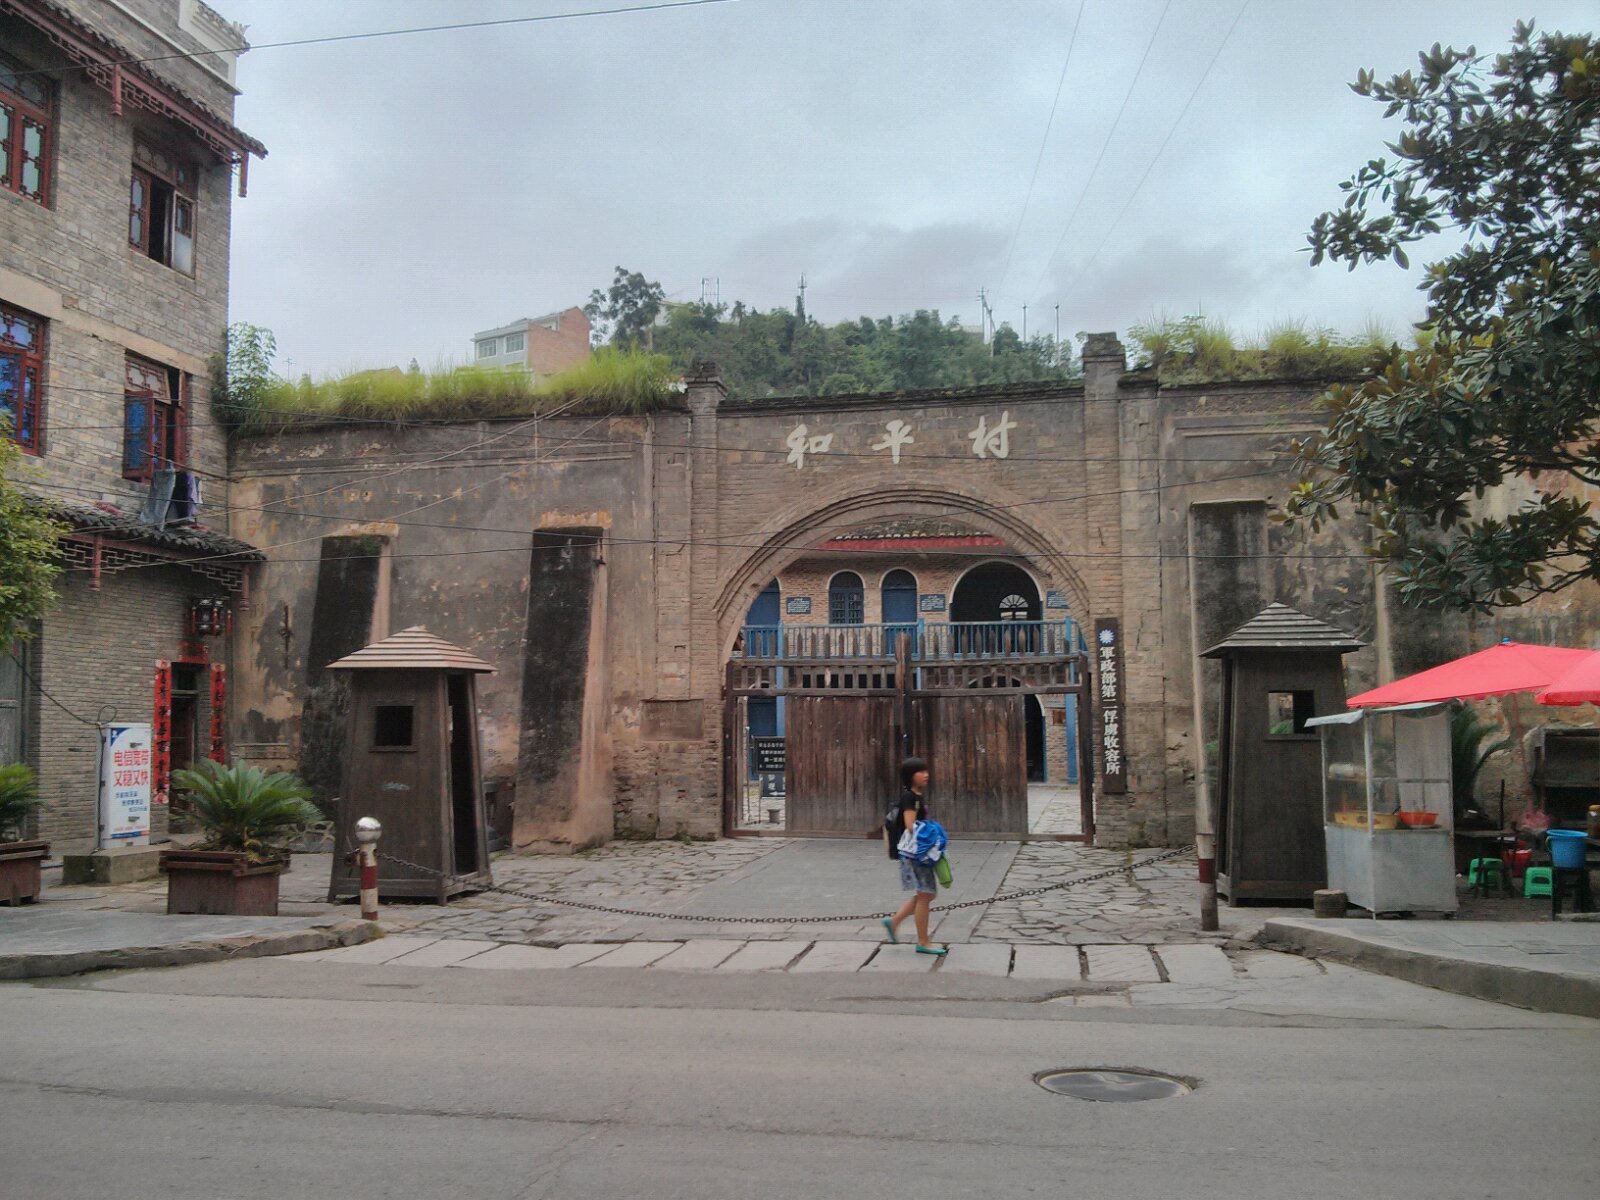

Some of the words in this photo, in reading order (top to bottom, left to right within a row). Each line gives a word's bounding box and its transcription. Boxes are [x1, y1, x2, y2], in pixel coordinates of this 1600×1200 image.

[786, 410, 1017, 470] 和平村
[1099, 646, 1121, 775] 軍政部第二俘虜收容所
[114, 750, 149, 766] 电信宽带
[113, 770, 148, 787] 又稳又快
